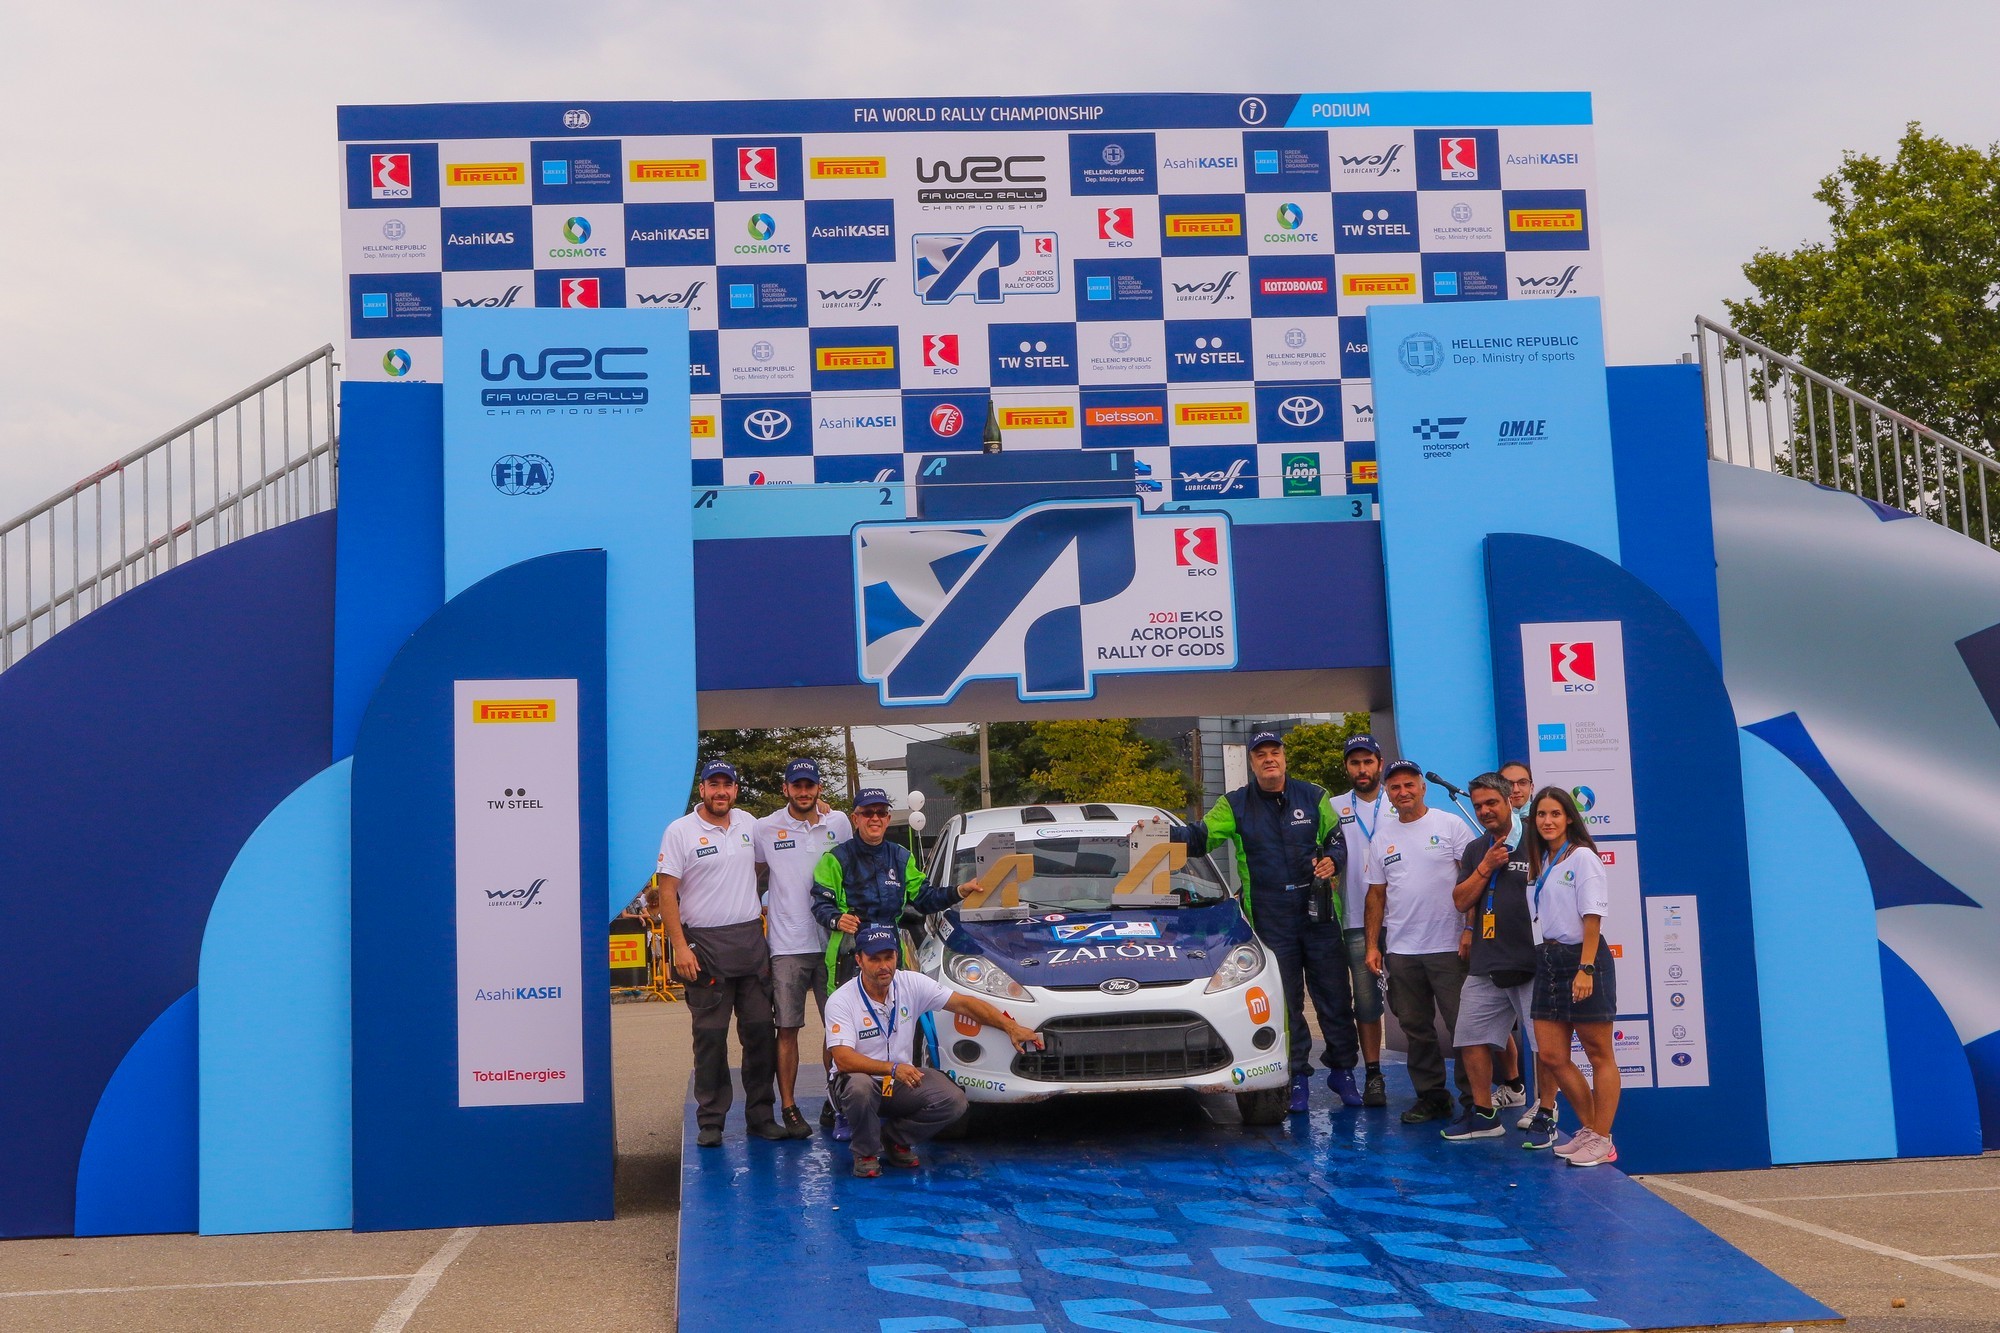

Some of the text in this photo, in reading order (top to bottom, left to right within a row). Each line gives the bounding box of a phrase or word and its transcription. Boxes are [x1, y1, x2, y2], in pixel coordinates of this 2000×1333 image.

[854, 105, 1103, 123] FIA WORLD RALLY CHAMPIONSHIP
[1311, 102, 1371, 118] PODIUM
[1163, 157, 1239, 169] AsahiKASEI
[1506, 153, 1579, 165] AsahiKASEI
[453, 166, 518, 182] PIRELLI
[637, 163, 700, 179] PIRELLI
[817, 160, 879, 175] PIRELLI
[916, 155, 1047, 183] WRC
[945, 192, 993, 200] WORLD
[997, 191, 1044, 199] RALLY
[1173, 217, 1234, 232] PIRELLI
[1516, 213, 1575, 227] PIRELLI
[631, 228, 709, 242] AsahiKASEI
[812, 224, 889, 238] AsahiKASEI
[1342, 224, 1410, 236] TW STEEL
[1264, 233, 1318, 243] COSMOTE
[549, 248, 607, 258] COSMOTE
[734, 244, 791, 254] COSMOTE
[1350, 276, 1409, 292] PIRELLI
[822, 301, 860, 309] LUBRICANTS
[1452, 336, 1579, 350] HELLENIC REPUBLIC
[480, 347, 649, 382] WRC
[824, 350, 886, 366] PIRELLI
[998, 356, 1069, 368] TW STEEL
[1174, 352, 1244, 365] TW STEEL
[1453, 351, 1575, 366] Dep. Ministry of sports
[689, 364, 711, 376] EEL
[486, 392, 644, 402] FIA WORLD RALLY
[486, 407, 644, 416] CHAMPIONSHIP
[1006, 410, 1068, 426] PIRELLI
[1182, 406, 1242, 422] PIRELLI
[818, 416, 896, 430] AsahiKASEI
[936, 408, 959, 433] 7 DAYS
[1422, 442, 1470, 452] motorsport
[1423, 450, 1452, 460] greece
[1286, 466, 1318, 482] Loop
[879, 488, 893, 506] 2
[1351, 500, 1363, 518] 3
[1188, 568, 1217, 577] EKO
[1149, 610, 1223, 624] 2021 EKO
[1130, 625, 1224, 642] ACROPOLIS
[1098, 643, 1224, 660] RALLY OF GODS
[1564, 683, 1594, 692] EKO
[480, 704, 548, 720] PIRELLI
[487, 799, 543, 809] TW STEEL
[1581, 815, 1610, 824] MOTE
[1109, 981, 1130, 991] Ford
[475, 986, 562, 1001] AsahiKASEI
[472, 1068, 566, 1082] TotalEnergies
[1246, 1062, 1282, 1078] COSMOTE
[957, 1076, 1006, 1092] COSMOTE
